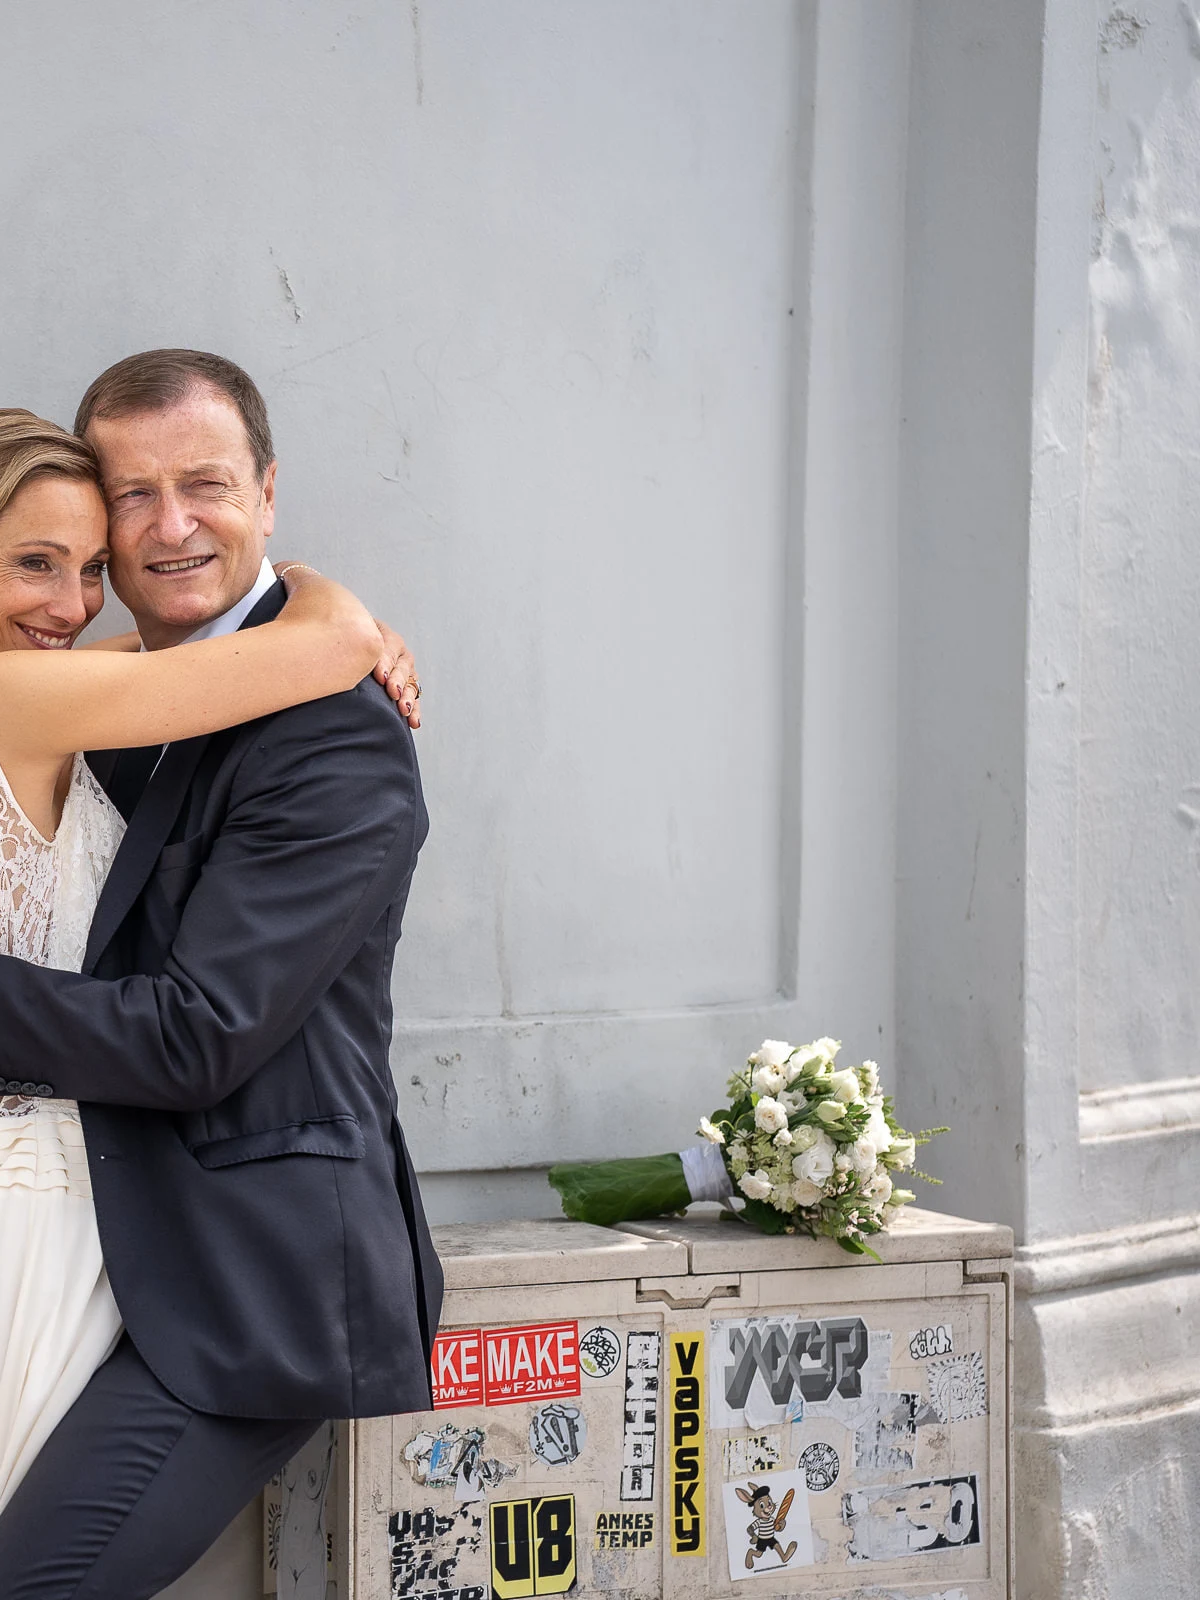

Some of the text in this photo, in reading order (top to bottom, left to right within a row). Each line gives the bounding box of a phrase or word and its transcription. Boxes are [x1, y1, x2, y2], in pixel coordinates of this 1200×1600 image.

[487, 1331, 576, 1383] MAKE
[513, 1378, 552, 1393] F2M
[597, 1513, 653, 1530] ANKES
[597, 1531, 653, 1548] TEMP
